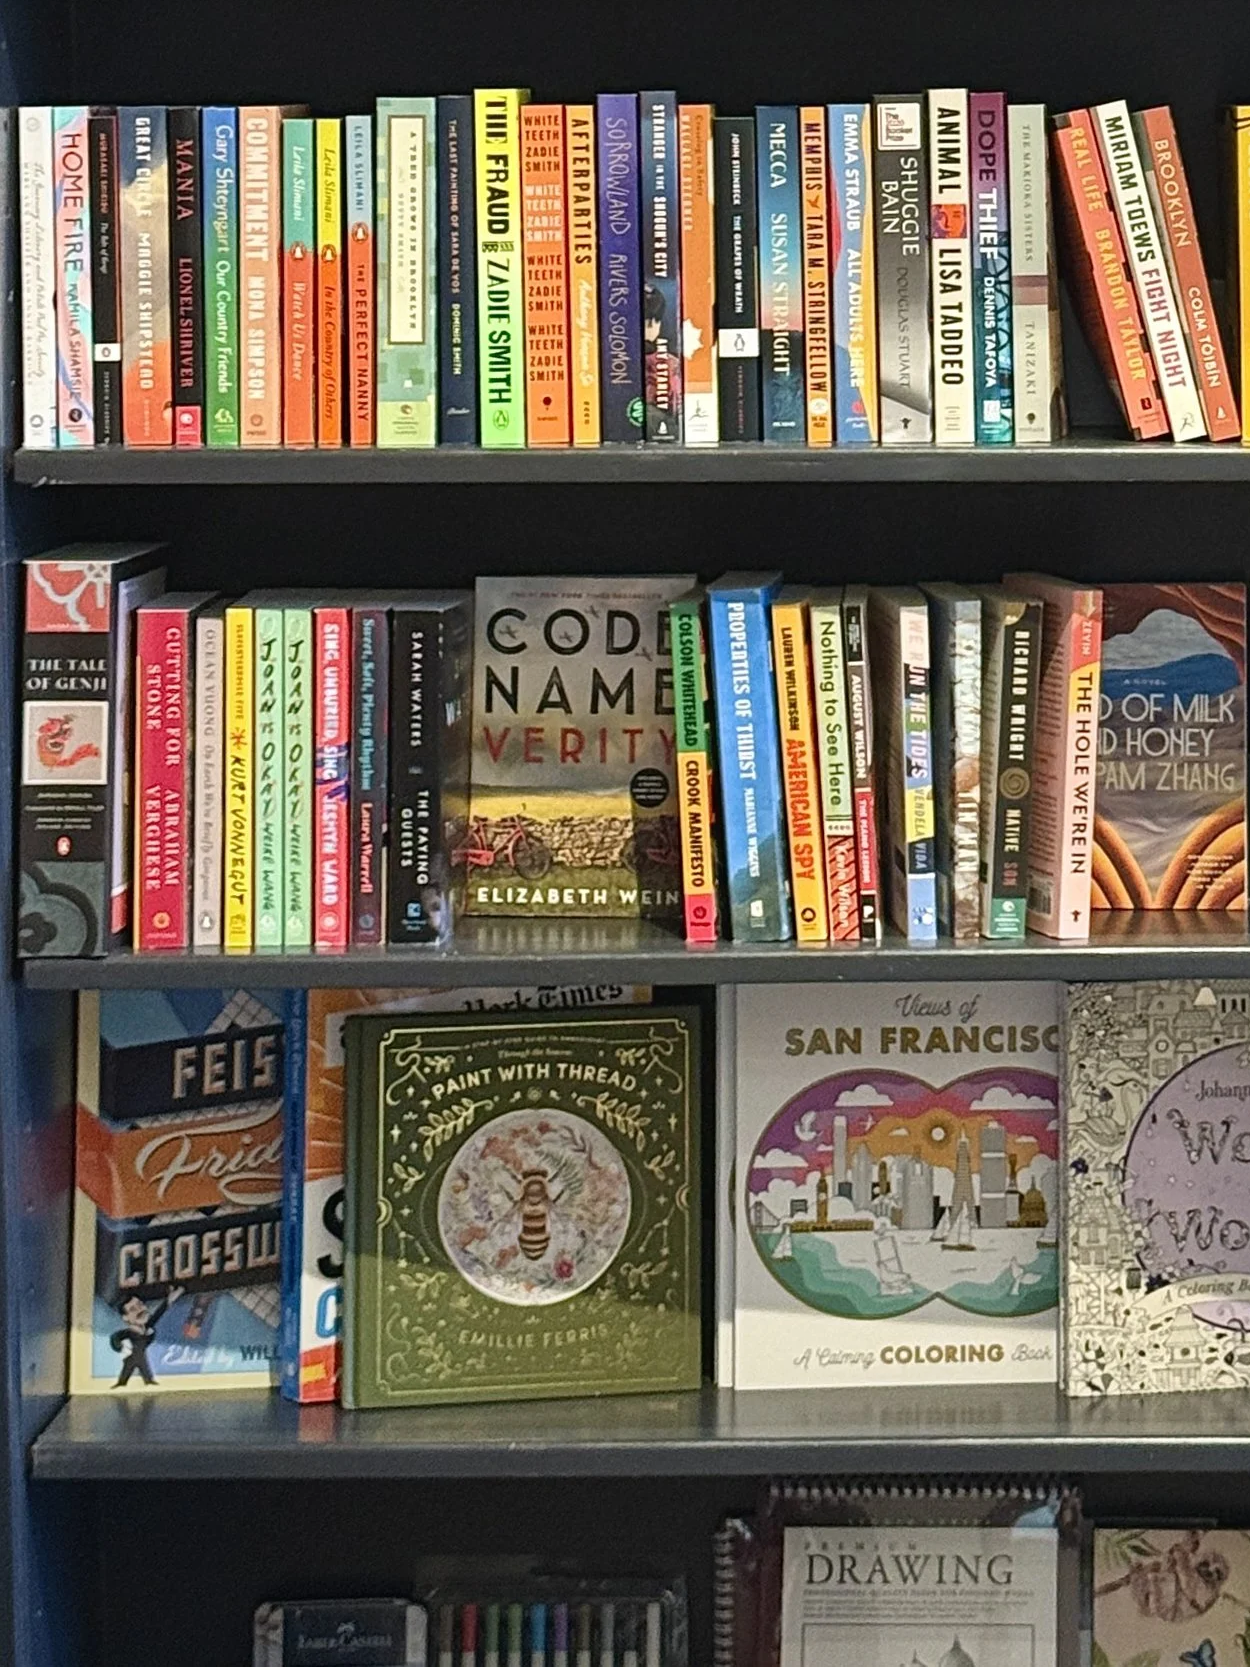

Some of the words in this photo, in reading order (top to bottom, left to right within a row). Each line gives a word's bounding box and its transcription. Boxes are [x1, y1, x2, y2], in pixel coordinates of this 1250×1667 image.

[937, 107, 961, 194] ANIMAL
[881, 181, 898, 234] BAIN
[901, 157, 919, 255] SHUGGIE
[940, 248, 962, 294] LISA
[941, 302, 964, 385] TADDEO
[477, 888, 607, 904] ELIZABETH
[785, 1027, 862, 1056] SAN
[432, 1072, 491, 1100] PAINT
[499, 1063, 550, 1082] WITH
[557, 1063, 638, 1092] THREAD
[880, 1345, 1003, 1364] COLORING
[804, 1554, 1014, 1585] DRAWING
